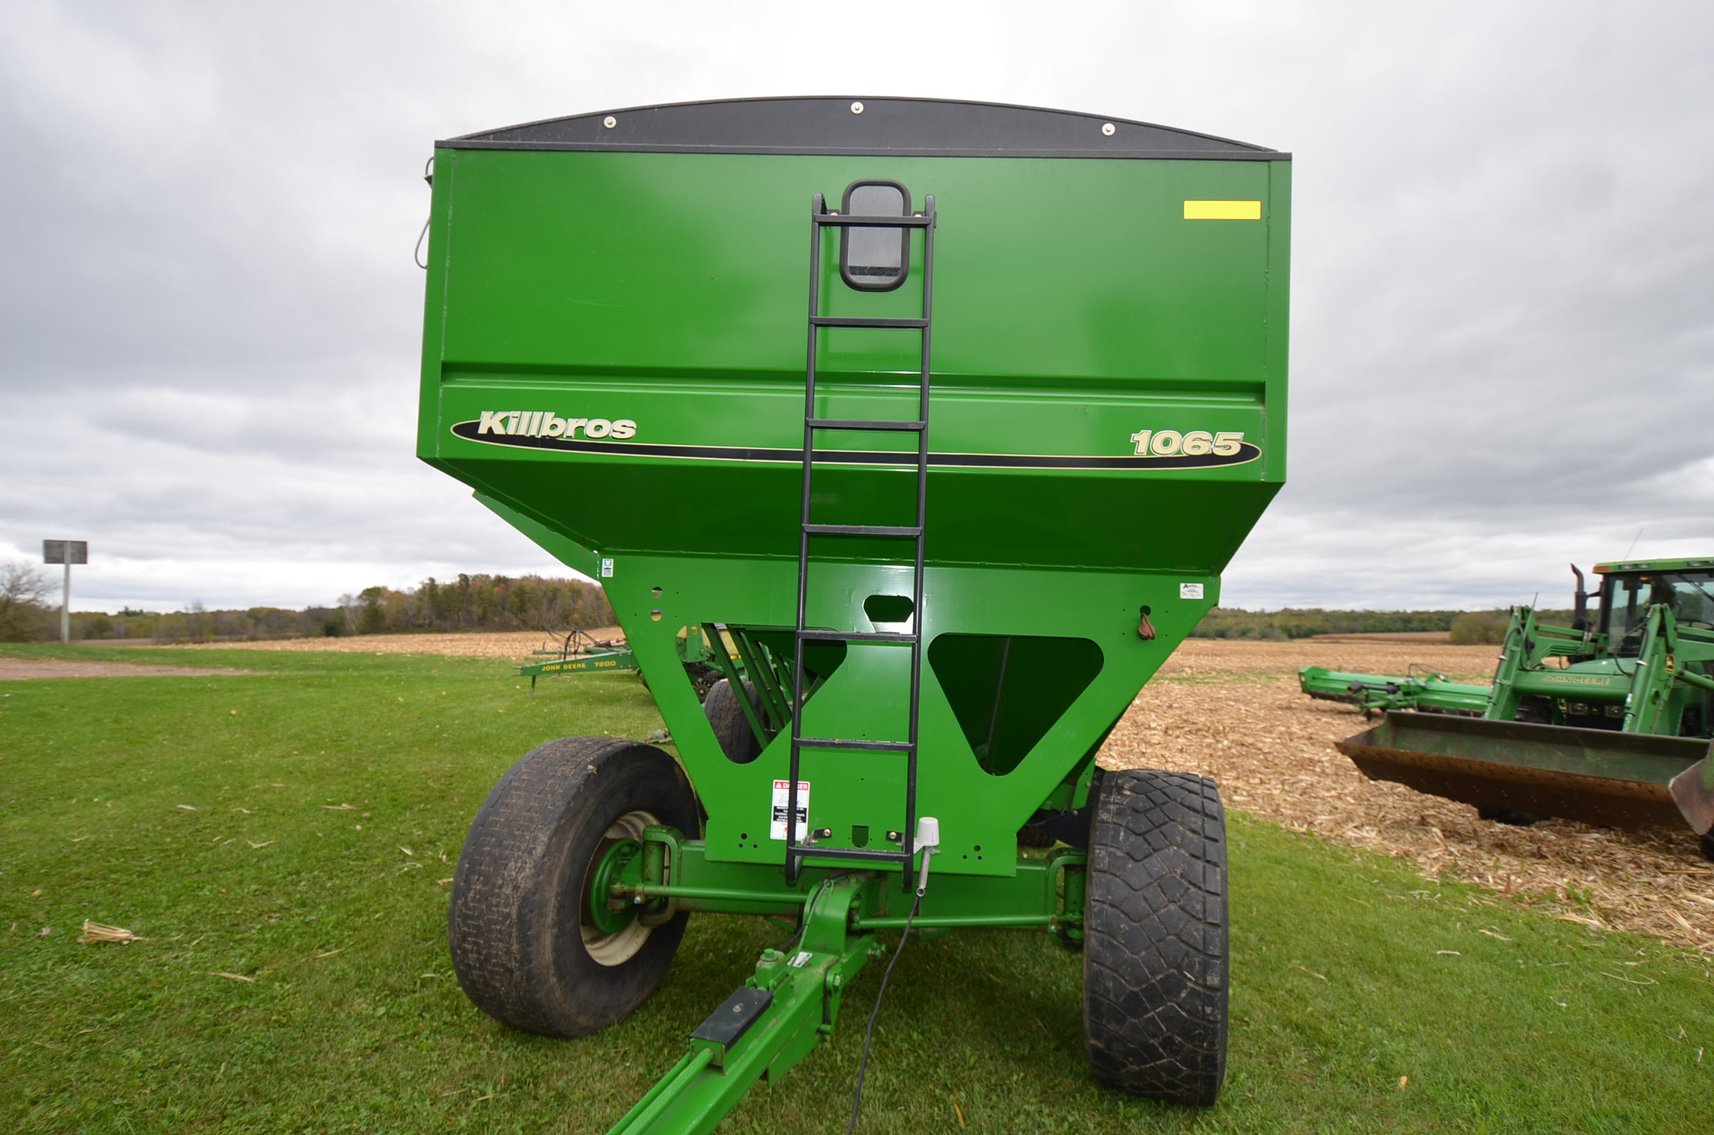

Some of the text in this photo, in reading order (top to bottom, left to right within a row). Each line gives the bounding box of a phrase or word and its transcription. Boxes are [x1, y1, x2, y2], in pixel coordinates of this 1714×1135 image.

[477, 411, 637, 439] Killbros
[1130, 430, 1244, 456] 1065
[563, 662, 586, 670] DEERE
